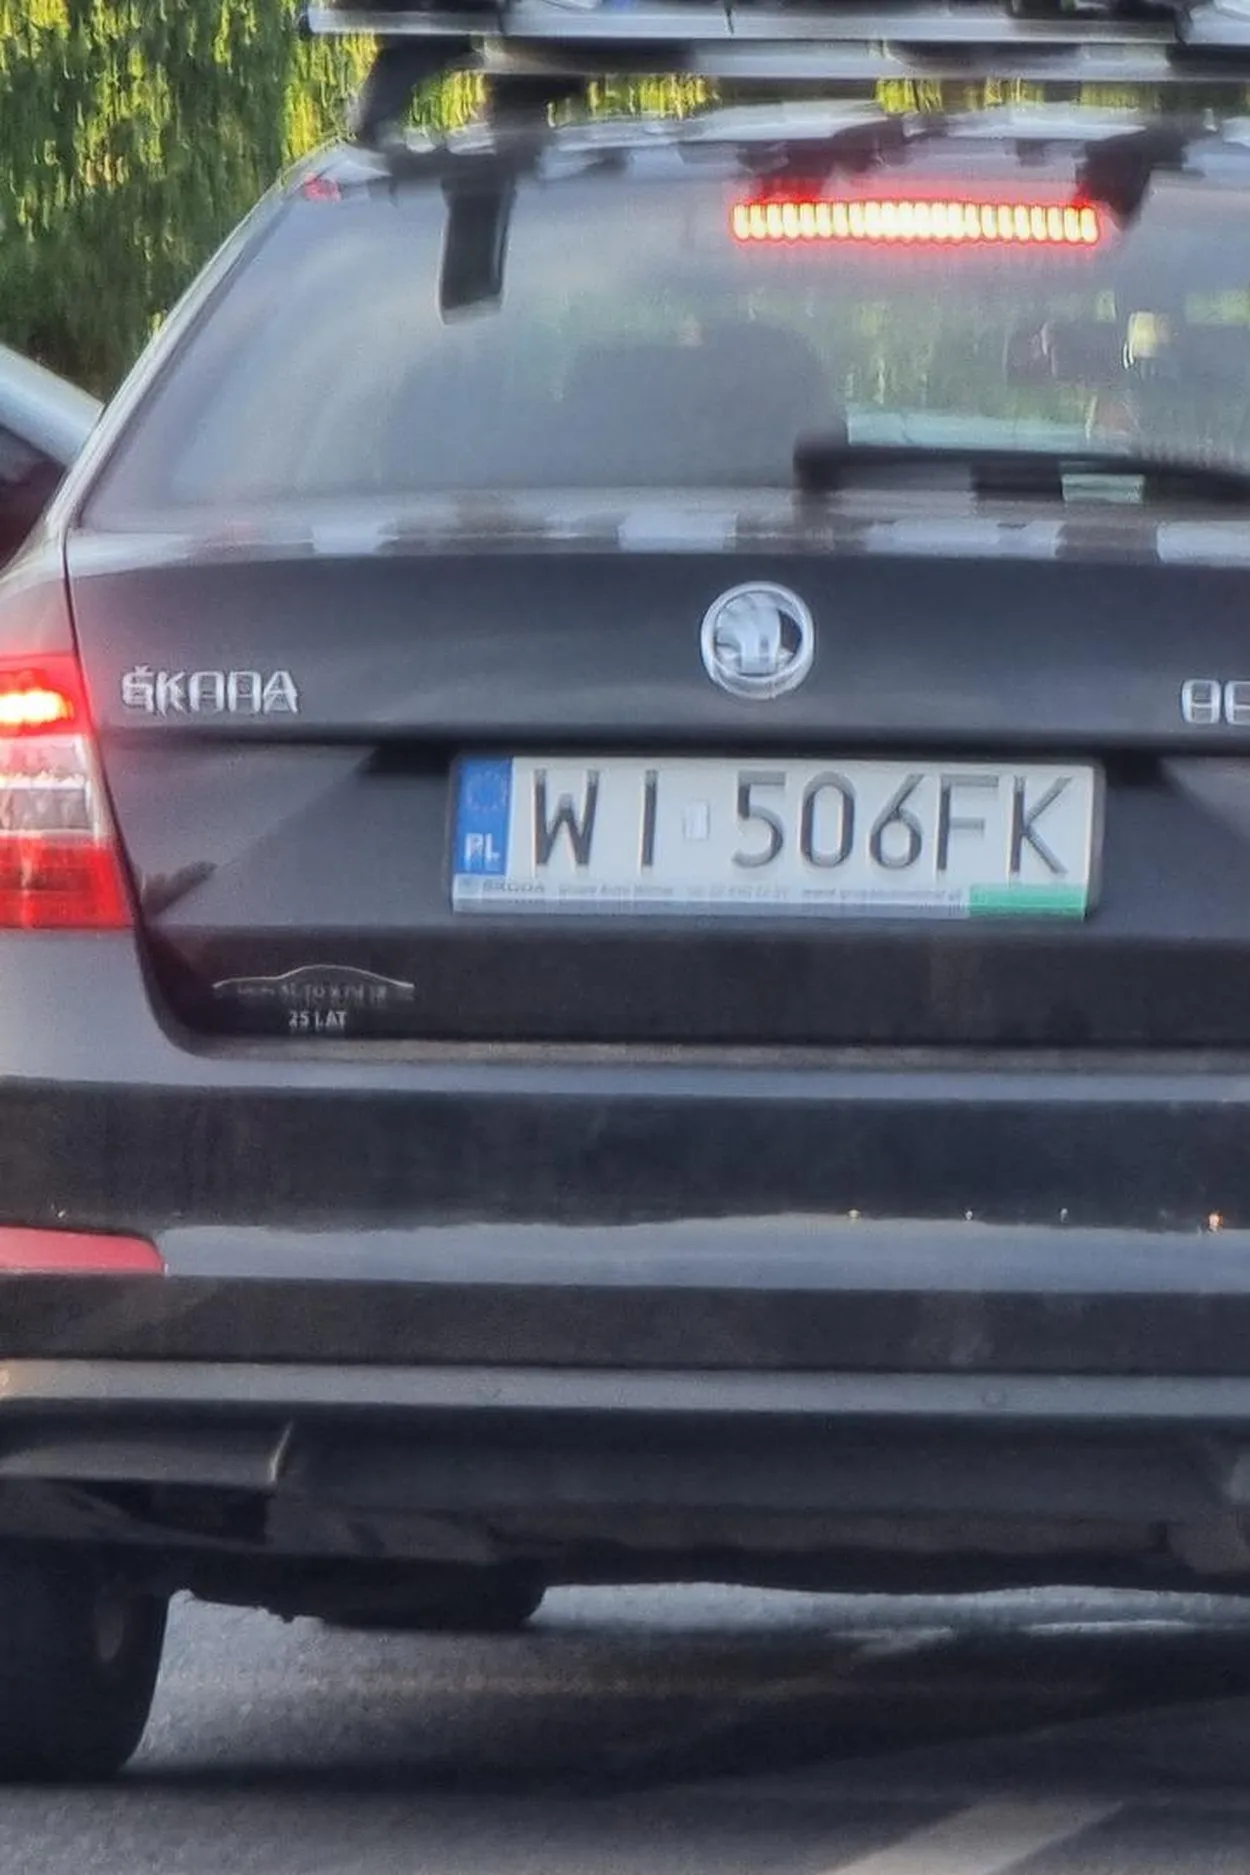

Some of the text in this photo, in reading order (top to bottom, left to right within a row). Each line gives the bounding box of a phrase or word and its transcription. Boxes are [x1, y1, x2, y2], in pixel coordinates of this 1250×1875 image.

[121, 665, 299, 714] ŠKODA
[533, 768, 1073, 874] WI 506FK
[464, 832, 501, 864] PL
[288, 1009, 347, 1028] 25 LAT
